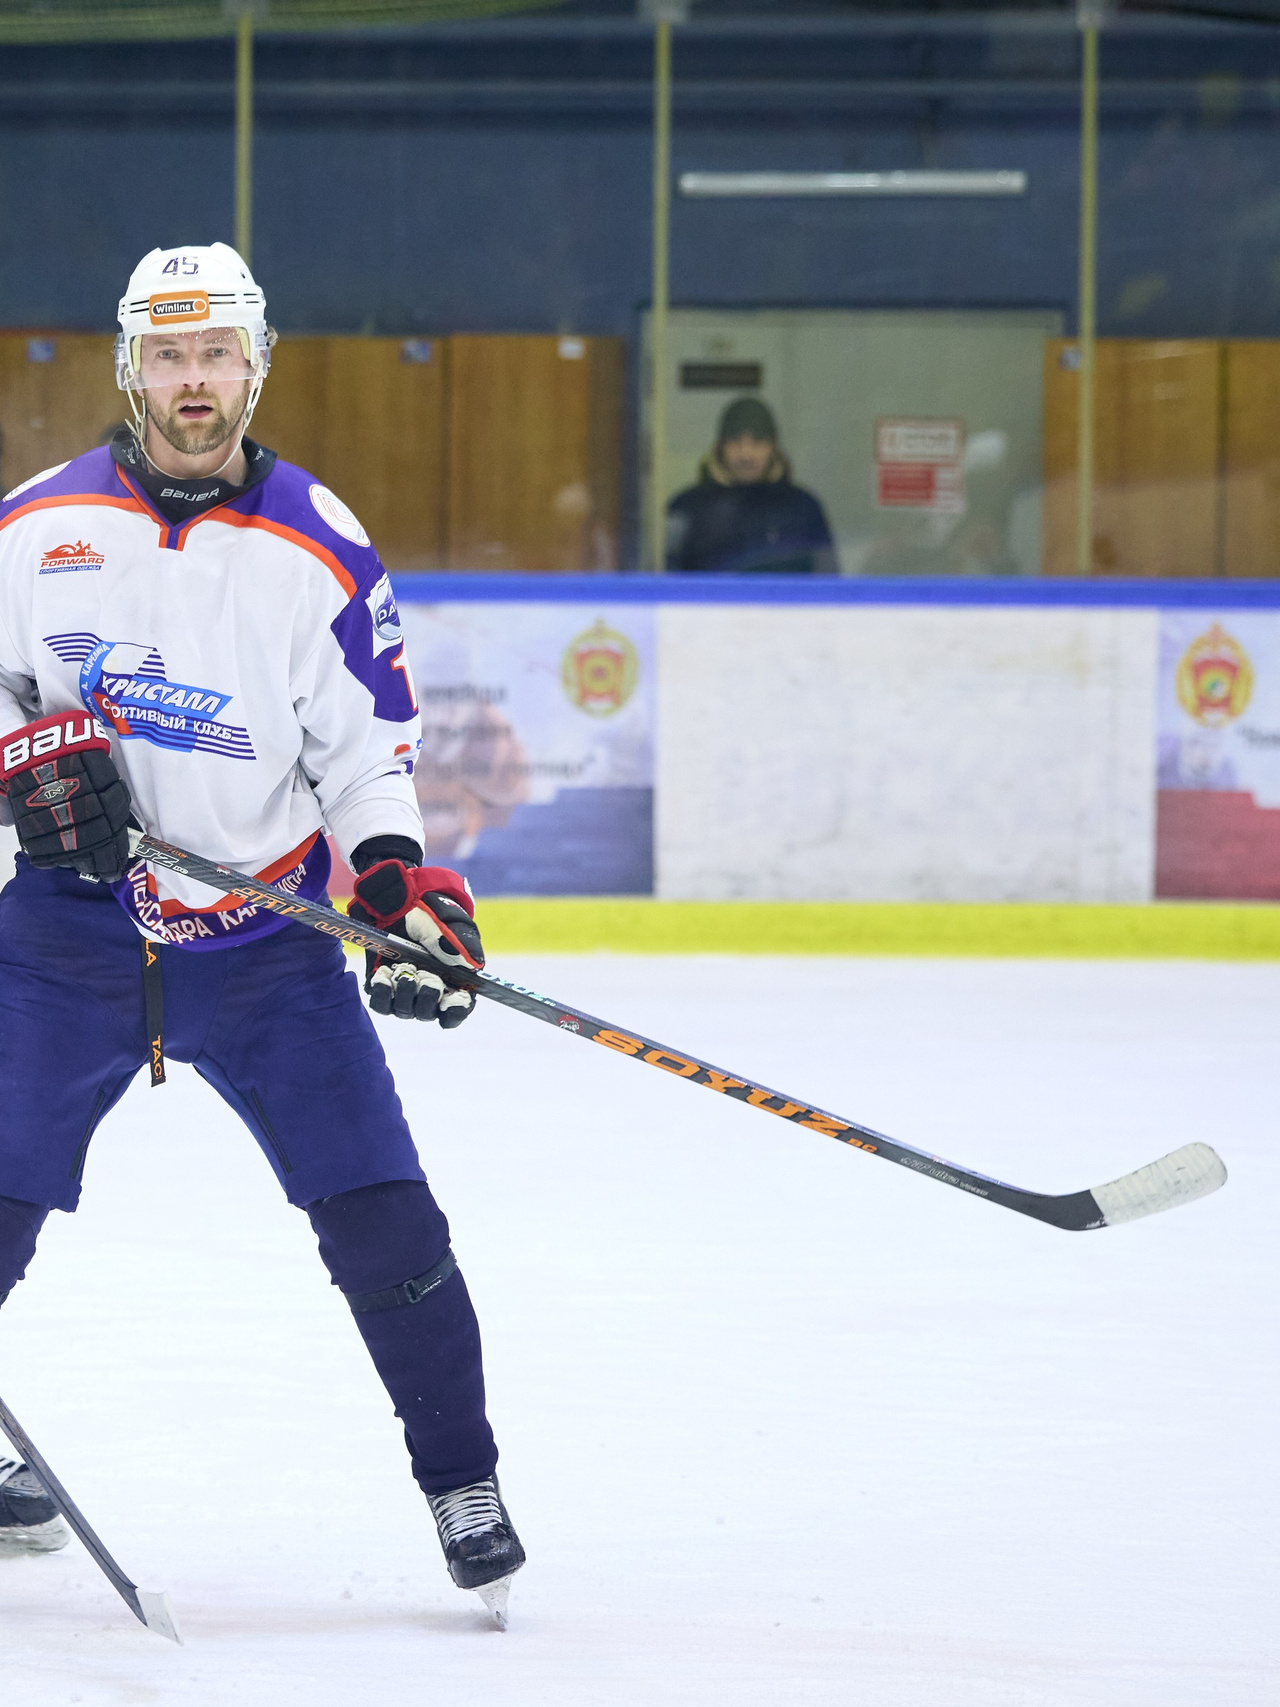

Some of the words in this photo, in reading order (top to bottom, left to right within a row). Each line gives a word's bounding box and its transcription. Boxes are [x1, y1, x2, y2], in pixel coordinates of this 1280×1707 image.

[161, 256, 199, 275] 45
[155, 302, 191, 314] Winline
[160, 487, 220, 503] BAUER
[40, 557, 105, 568] FORWARD
[101, 674, 223, 714] КРИСТАЛЛ
[193, 719, 234, 741] КЛУБ
[591, 1029, 850, 1139] SOYUZ
